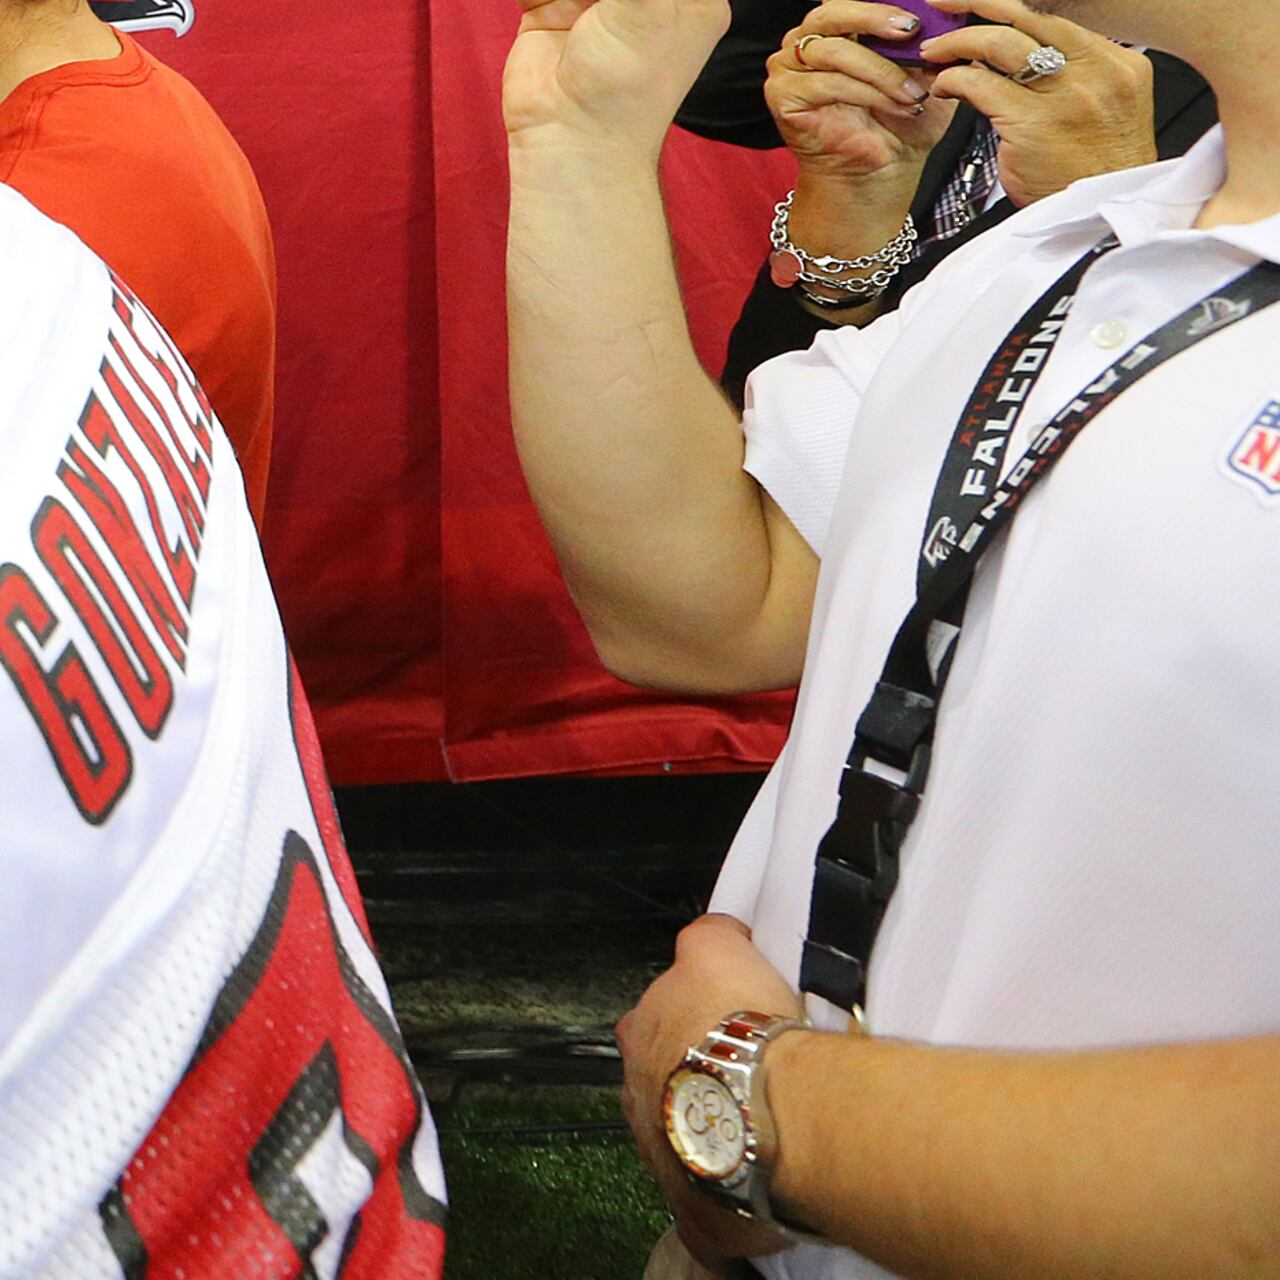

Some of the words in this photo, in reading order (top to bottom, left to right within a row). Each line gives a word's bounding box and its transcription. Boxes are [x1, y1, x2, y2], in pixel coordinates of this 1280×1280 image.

[957, 342, 1159, 554] FALCONS
[959, 332, 1030, 447] ATLANTA
[959, 294, 1075, 497] FALCONS
